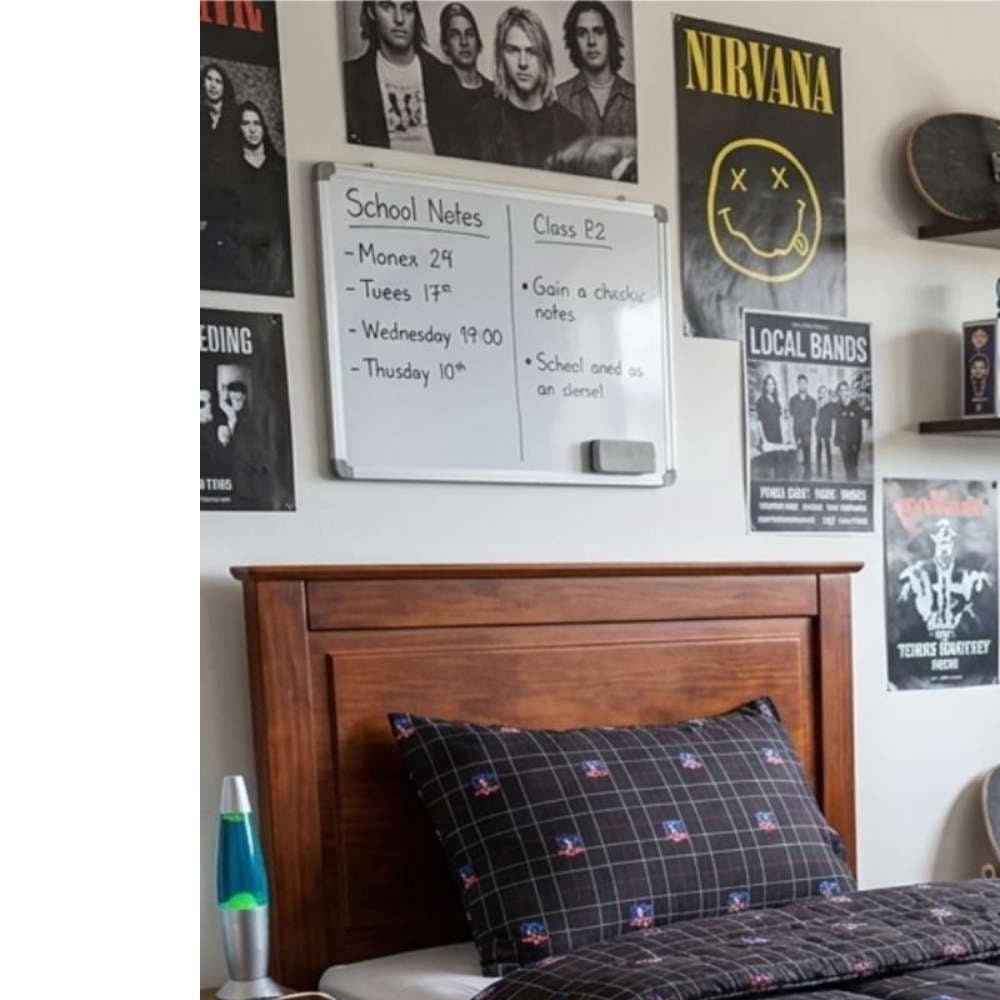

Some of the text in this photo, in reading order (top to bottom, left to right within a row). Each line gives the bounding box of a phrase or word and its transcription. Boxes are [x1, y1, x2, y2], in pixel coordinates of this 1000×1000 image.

[682, 27, 834, 115] NIRVANA
[345, 187, 416, 222] School
[533, 212, 577, 238] Class
[358, 242, 418, 268] Monex
[359, 278, 412, 302] Tuees
[532, 275, 570, 297] Gain
[577, 286, 587, 299] a
[535, 303, 576, 322] notes
[361, 319, 452, 349] Wednesday
[749, 326, 868, 363] LOCAL BANDS
[362, 357, 430, 389] Thusday
[537, 384, 555, 396] an
